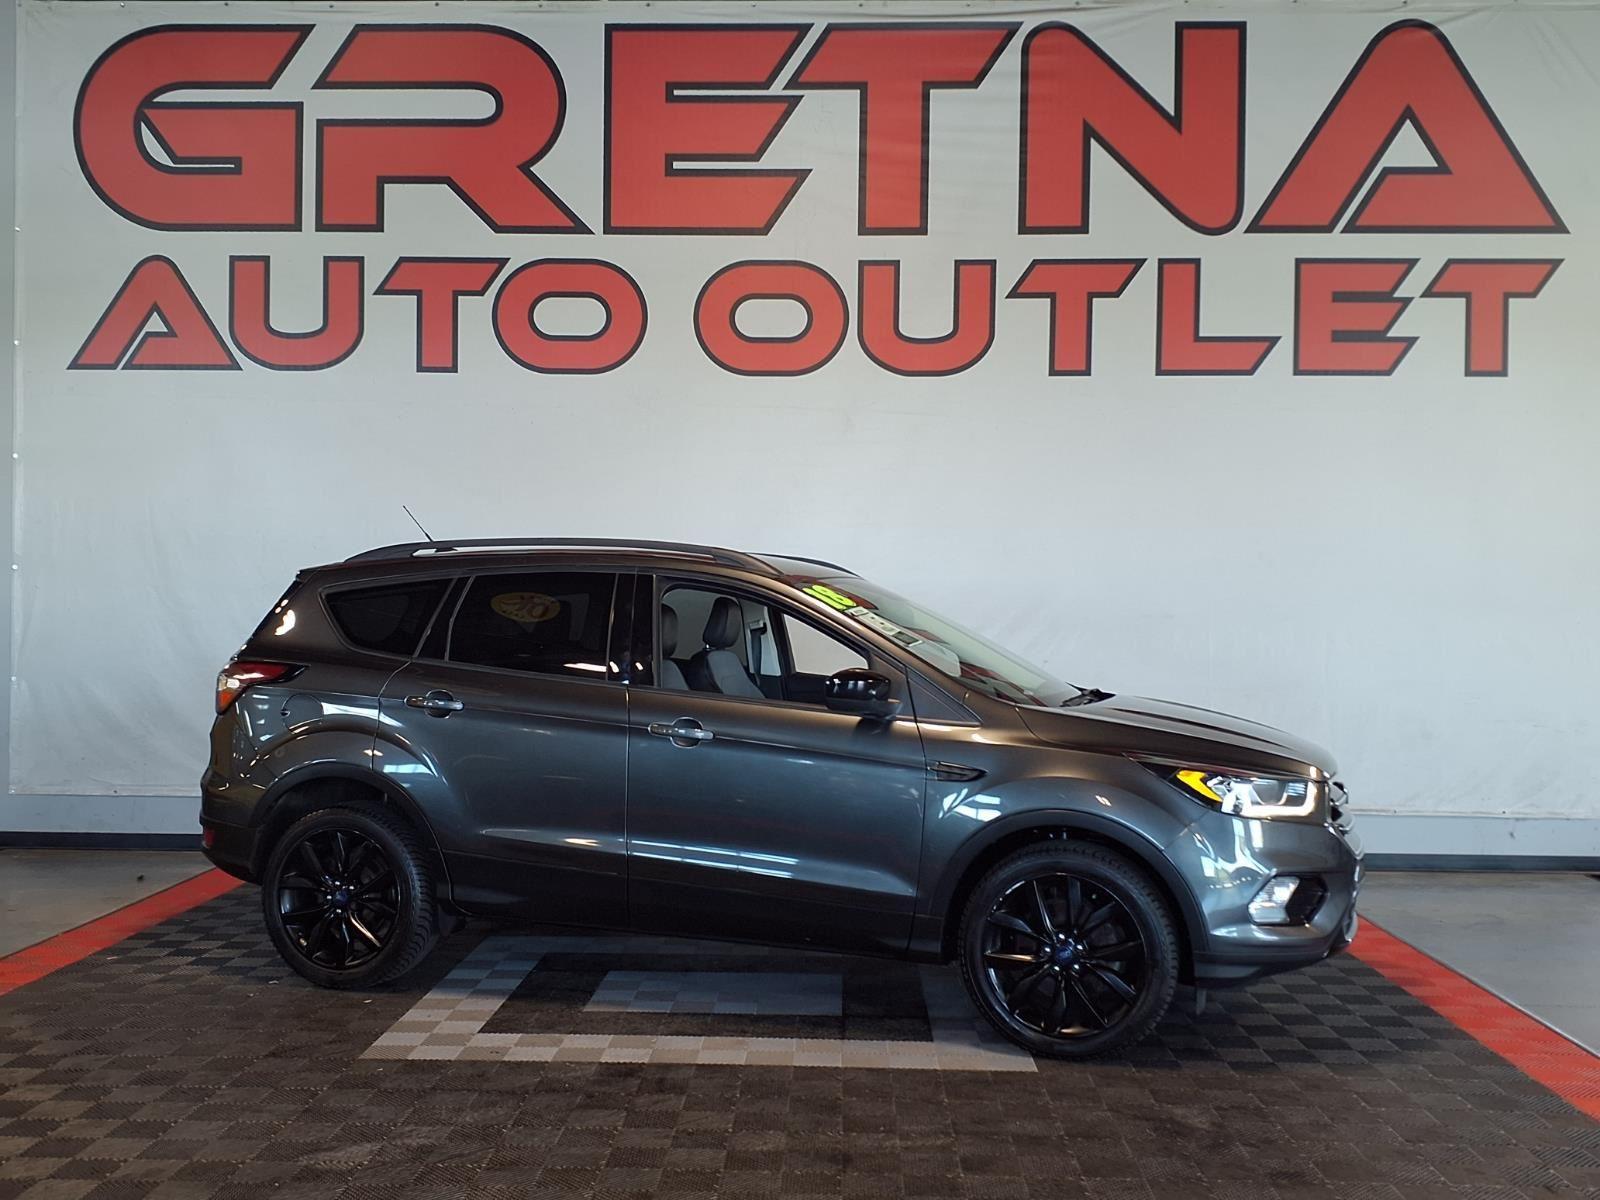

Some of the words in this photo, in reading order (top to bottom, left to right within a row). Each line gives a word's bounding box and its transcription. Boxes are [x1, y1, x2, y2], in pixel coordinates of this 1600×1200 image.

[73, 19, 1571, 236] GRETNA
[67, 255, 648, 374] AUTO
[694, 257, 1565, 377] OUTLET
[802, 584, 857, 610] 18
